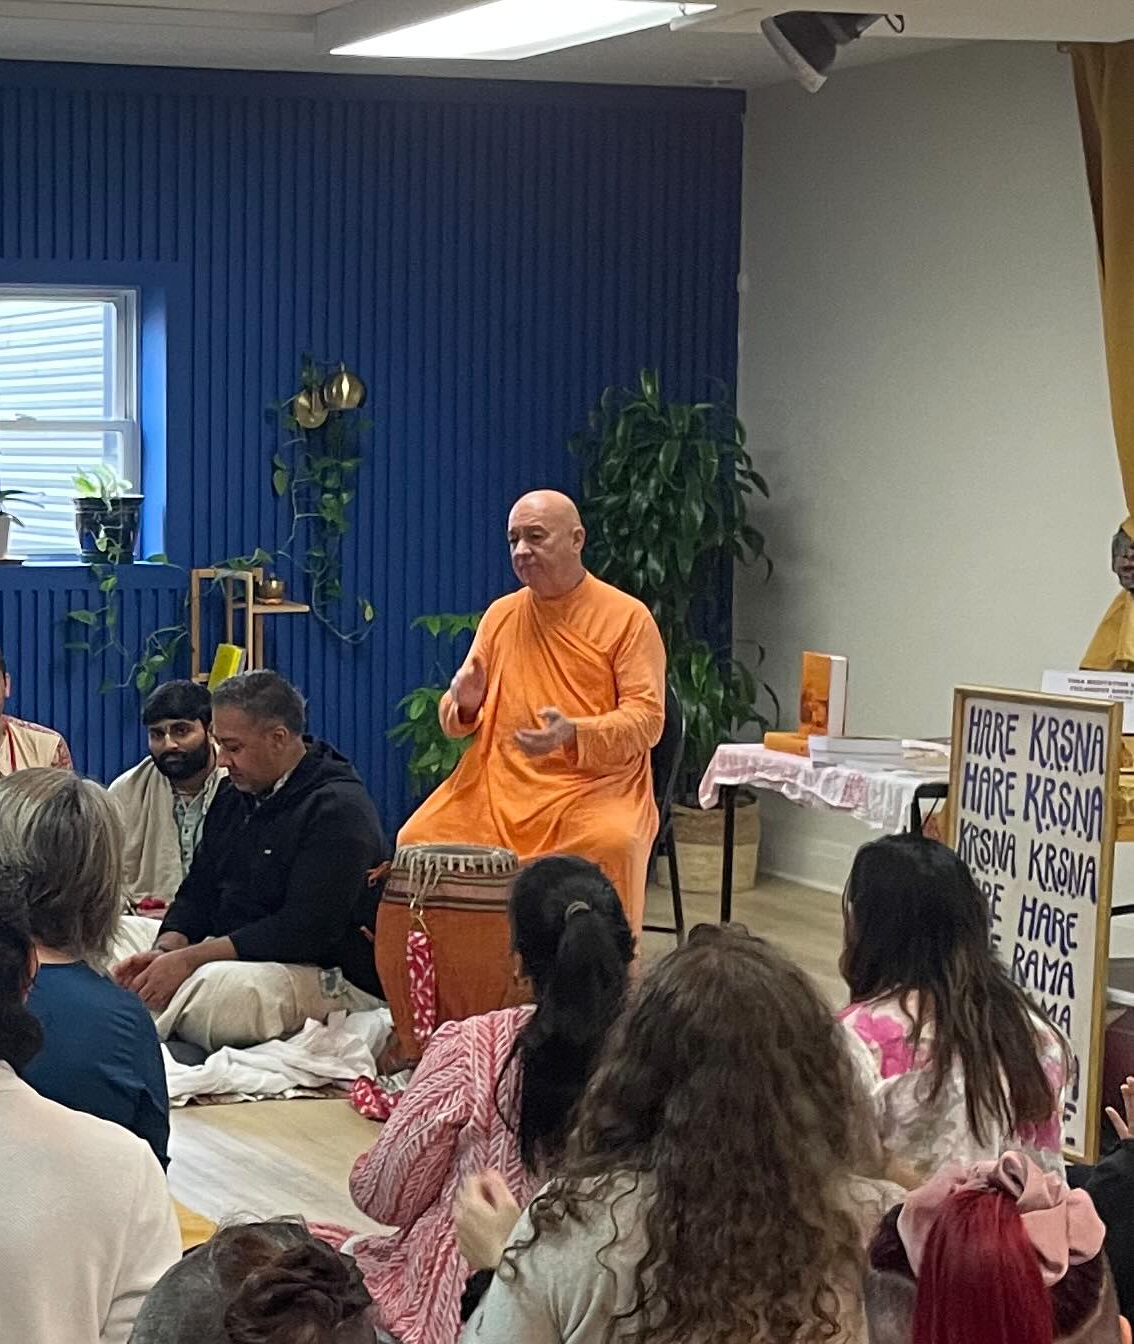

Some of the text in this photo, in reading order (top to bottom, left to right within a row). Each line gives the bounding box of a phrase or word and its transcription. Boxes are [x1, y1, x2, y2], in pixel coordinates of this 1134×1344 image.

[967, 705, 1019, 763] HARE
[961, 761, 1017, 825] HARE
[1017, 894, 1079, 957] HARE
[1011, 942, 1075, 999] RAMA
